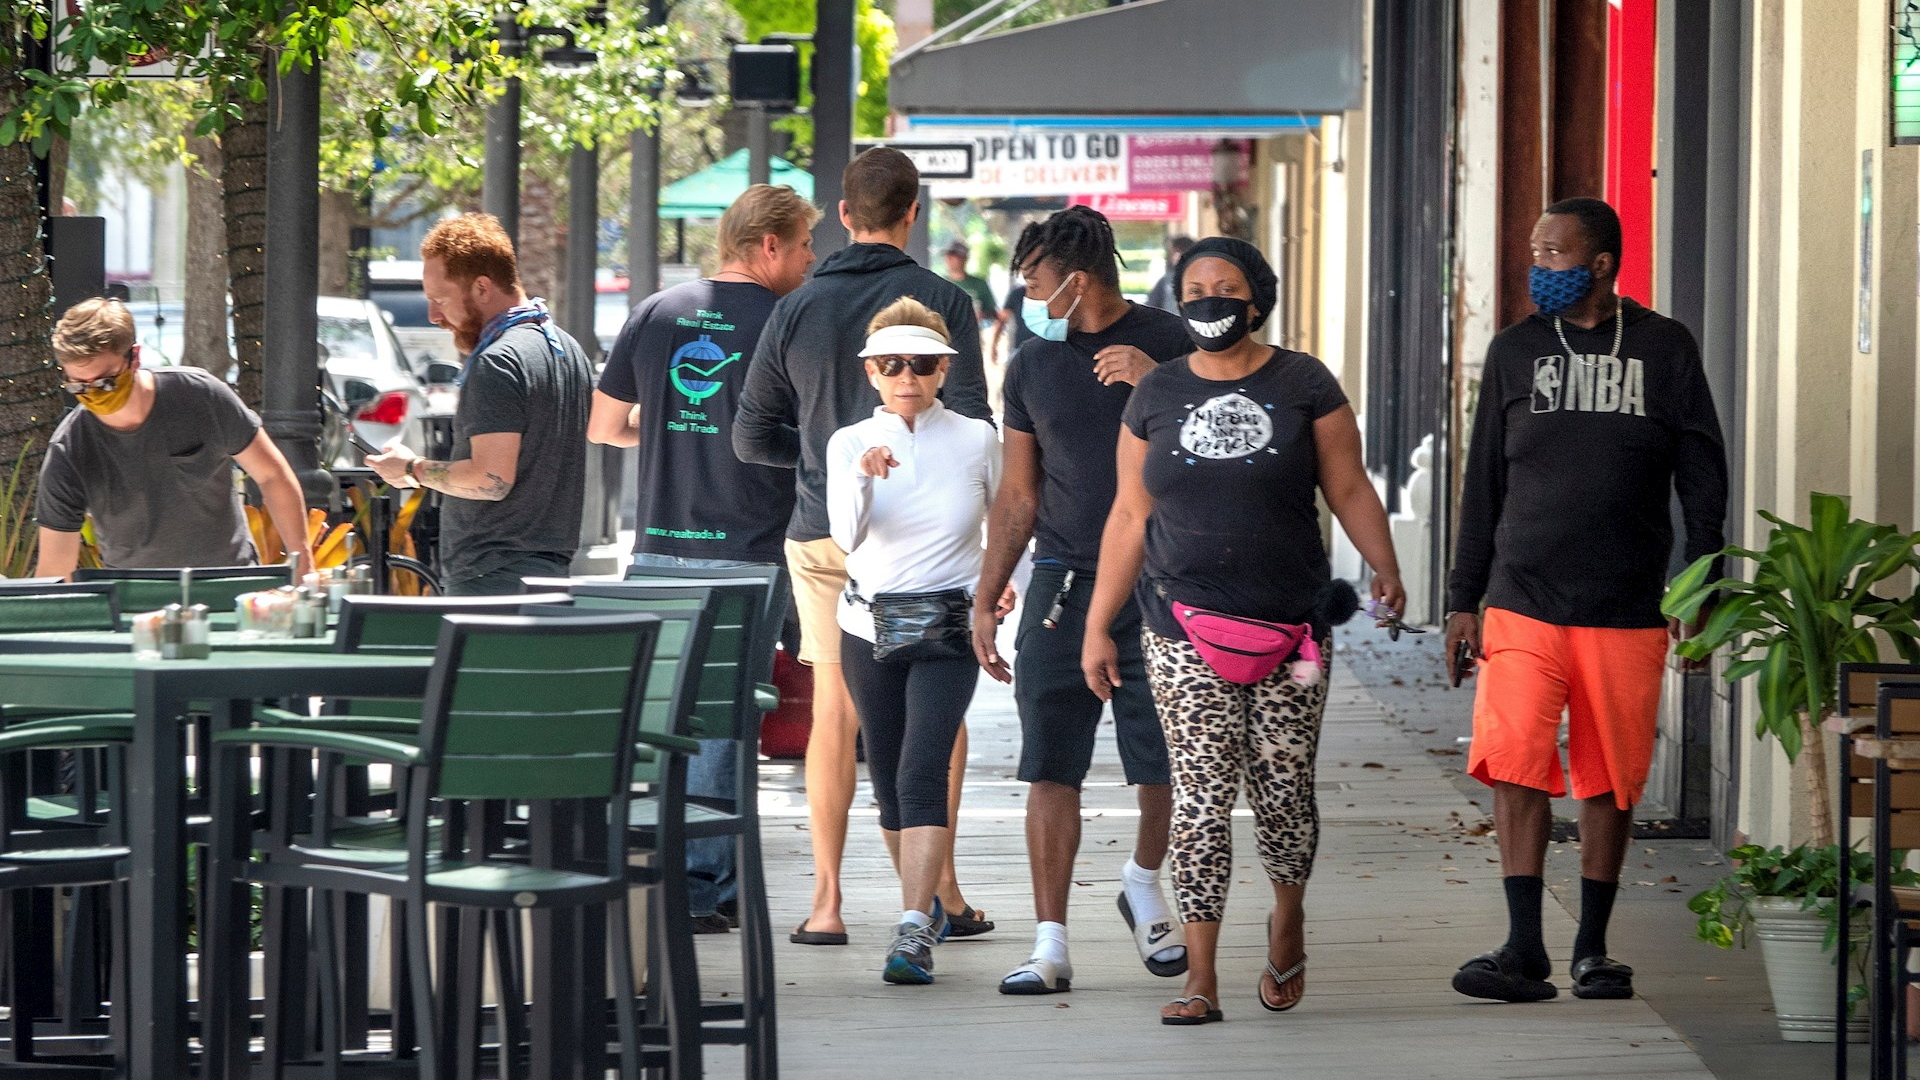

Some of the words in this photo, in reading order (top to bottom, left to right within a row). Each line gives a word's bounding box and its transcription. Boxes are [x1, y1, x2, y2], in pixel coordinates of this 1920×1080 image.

[976, 135, 1036, 161] OPEN
[1047, 135, 1076, 159] TO
[1086, 134, 1119, 158] GO
[1024, 165, 1120, 185] DELIVERY
[696, 308, 723, 319] Think
[676, 317, 700, 328] Real
[702, 320, 735, 331] Estate
[1564, 353, 1646, 417] NBA
[679, 410, 707, 421] Think
[666, 421, 688, 431] Real
[689, 422, 719, 434] Trade
[645, 527, 726, 540] www.realtrade.io
[1150, 921, 1170, 935] NIKE
